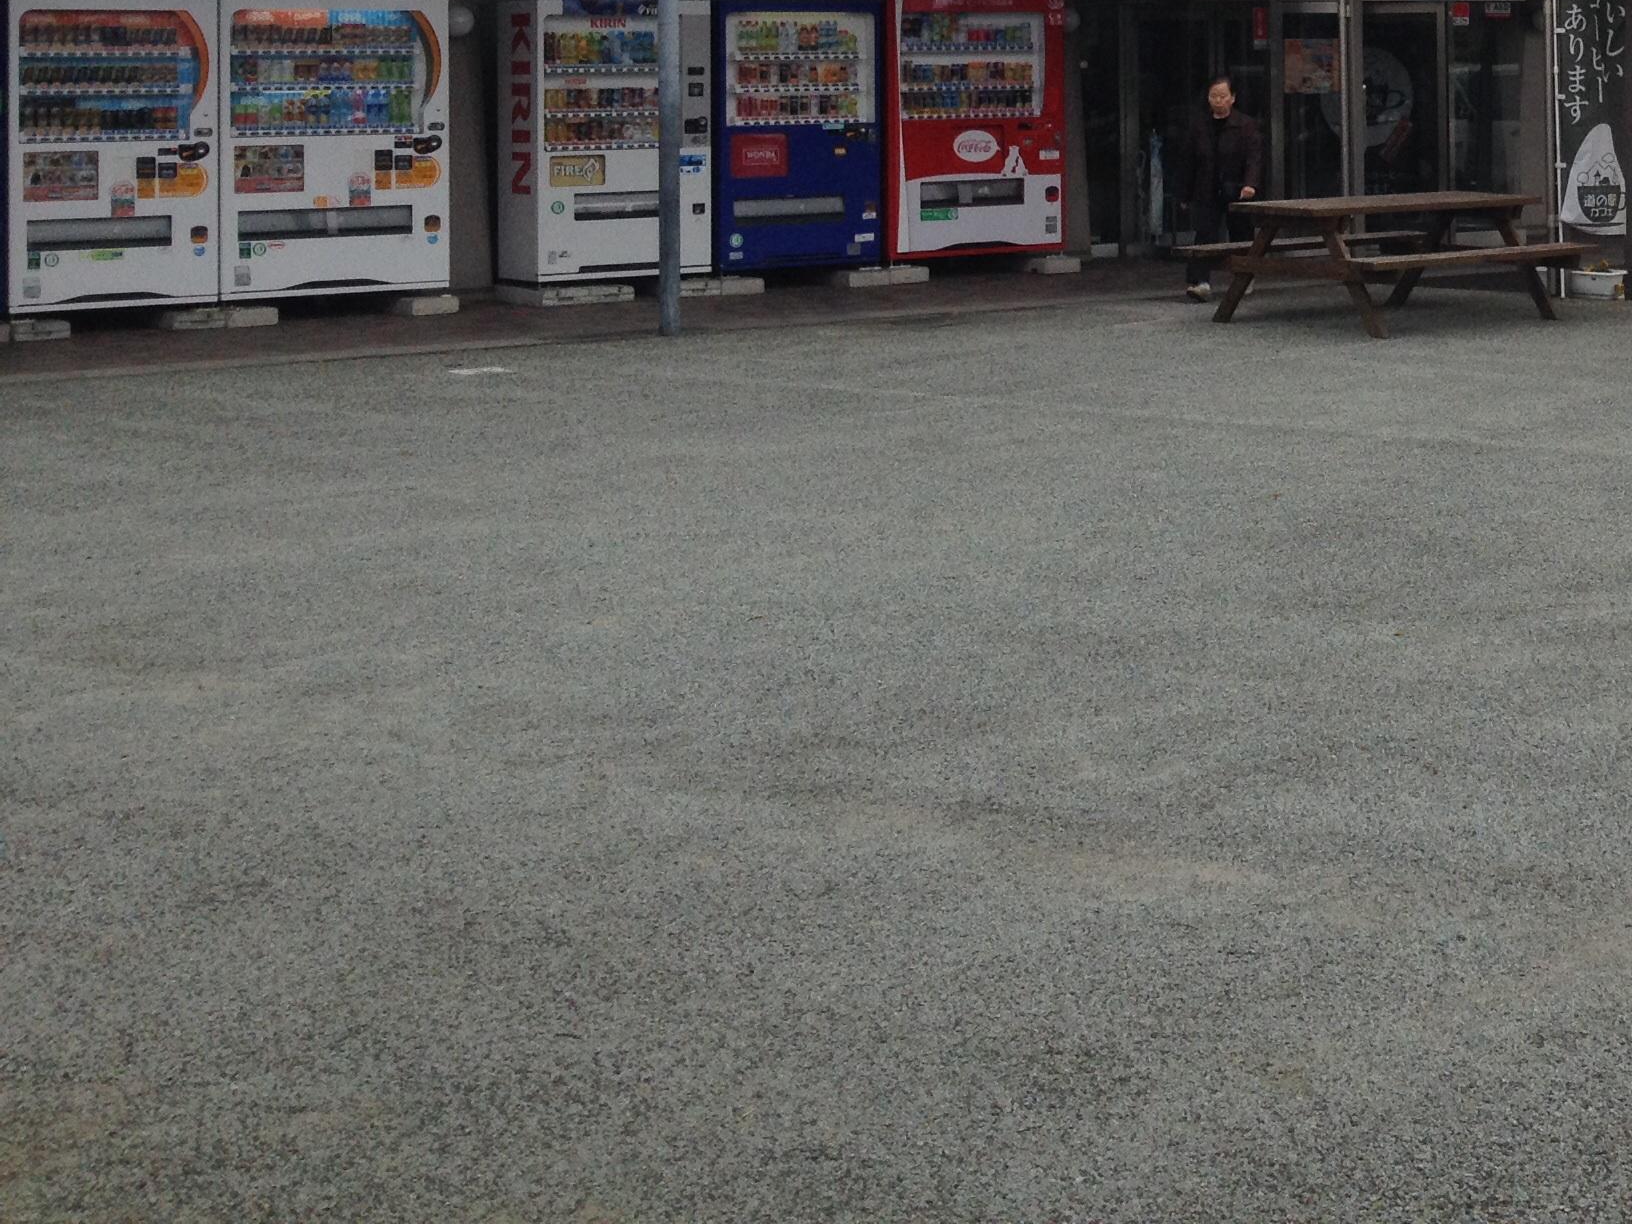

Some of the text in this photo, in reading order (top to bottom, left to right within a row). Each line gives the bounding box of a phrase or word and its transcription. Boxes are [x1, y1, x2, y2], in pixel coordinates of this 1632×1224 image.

[590, 17, 627, 29] KIRIN
[1564, 3, 1589, 125] あります
[511, 12, 532, 195] KIRIN
[553, 165, 584, 177] FIRE
